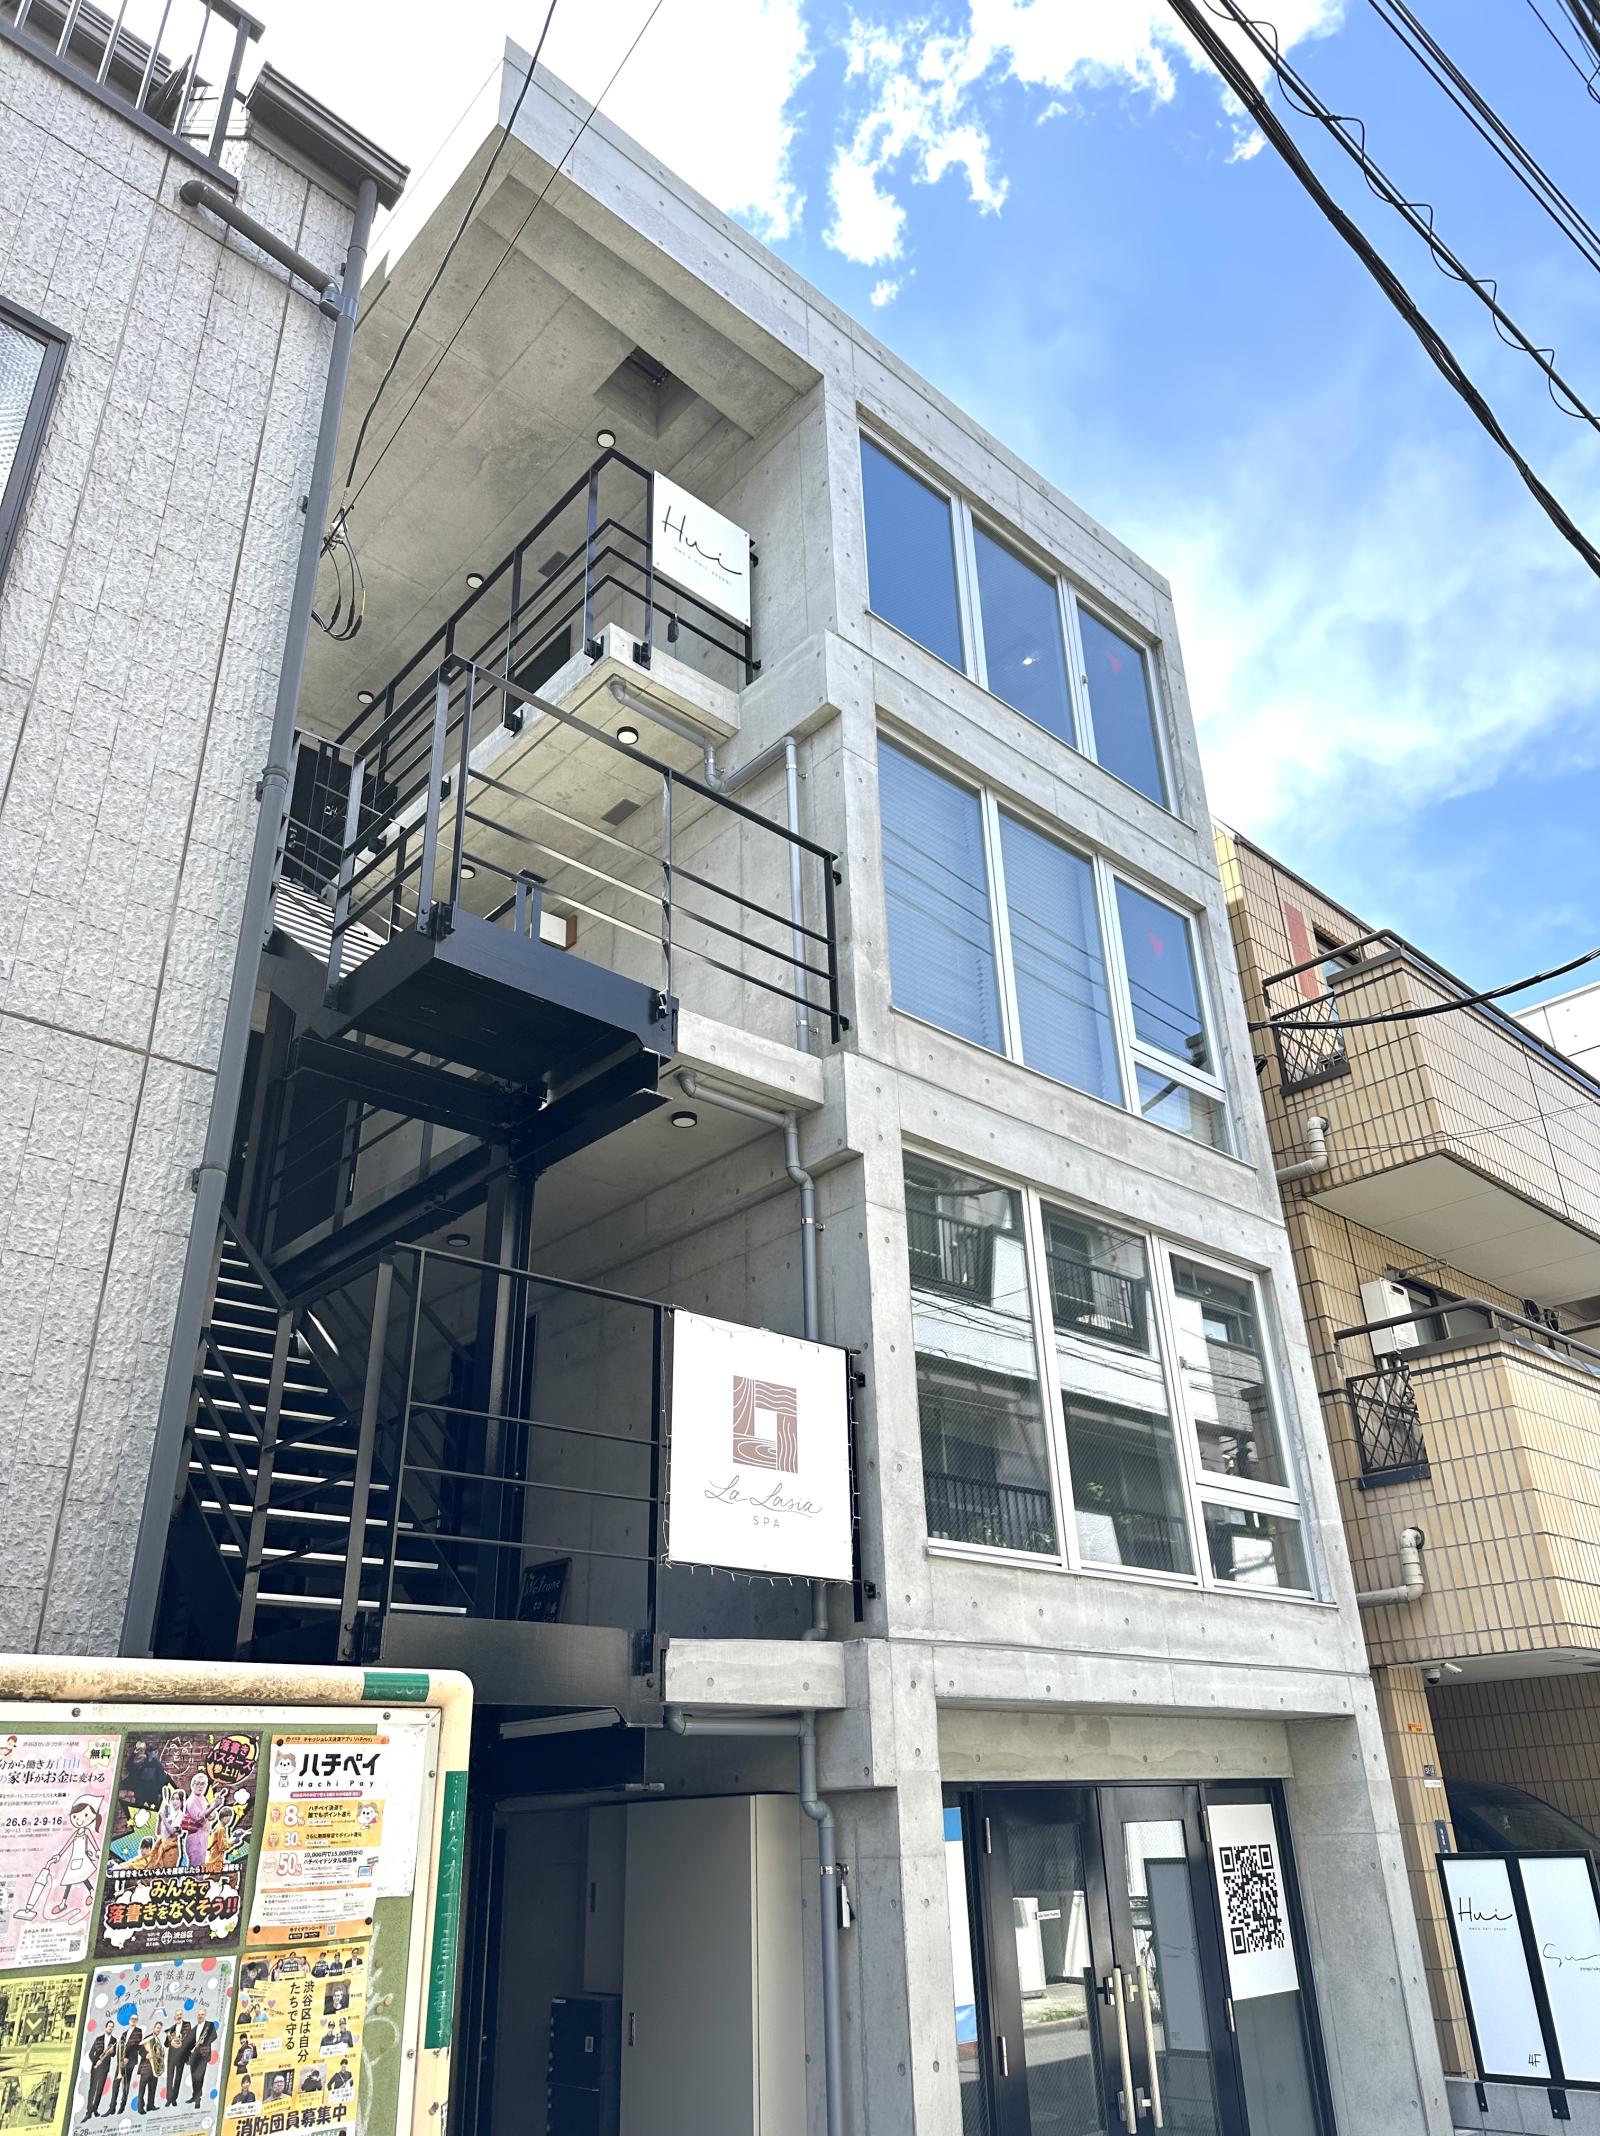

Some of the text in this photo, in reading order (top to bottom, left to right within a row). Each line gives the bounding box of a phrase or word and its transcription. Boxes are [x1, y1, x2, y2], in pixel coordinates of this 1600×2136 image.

[662, 505, 742, 575] Hui
[704, 1475, 748, 1504] La
[753, 1515, 780, 1529] SPA
[220, 1738, 249, 1756] 落書き
[207, 1750, 254, 1770] バスターズ
[299, 1753, 381, 1777] ハチペイ
[297, 1780, 374, 1788] Hachi Pay
[150, 1879, 210, 1898] みんなで
[108, 1897, 239, 1924] 落書きをなくそう!!
[1458, 1896, 1513, 1923] Hui
[172, 1930, 194, 1939] 渋谷区
[285, 1983, 301, 2051] たちで守る
[297, 1980, 316, 2064] 渋谷区は自分
[1528, 2053, 1542, 2068] 4F
[235, 2103, 347, 2136] 消防団員募集中
